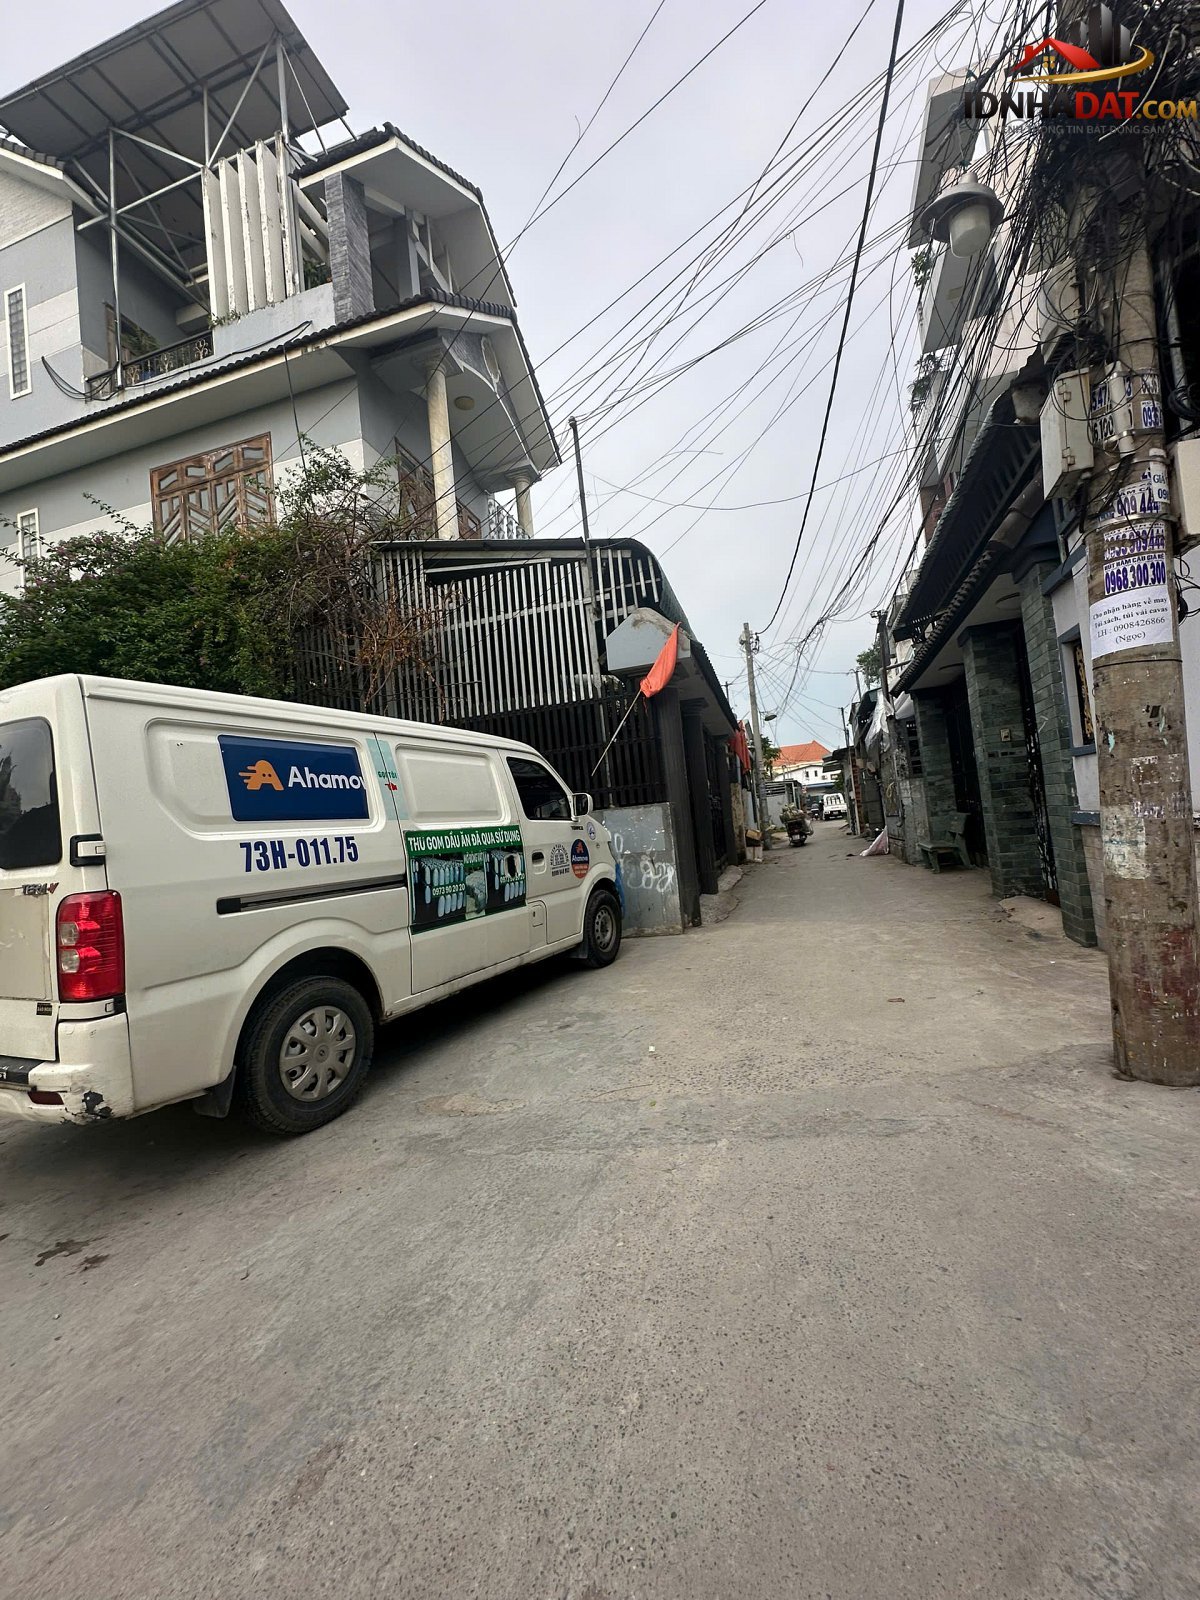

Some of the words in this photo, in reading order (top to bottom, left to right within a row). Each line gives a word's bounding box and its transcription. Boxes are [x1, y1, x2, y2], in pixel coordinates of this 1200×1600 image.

[1105, 561, 1166, 594] 0968.300.300
[1122, 601, 1142, 610] hàng
[1113, 616, 1166, 633] 0908426866
[1115, 631, 1146, 644] (Ngọc)
[408, 836, 426, 851] THU
[426, 836, 445, 850] GOM
[460, 830, 471, 847] ĂN
[481, 831, 496, 846] QUA
[239, 836, 359, 873] 73H-011.75
